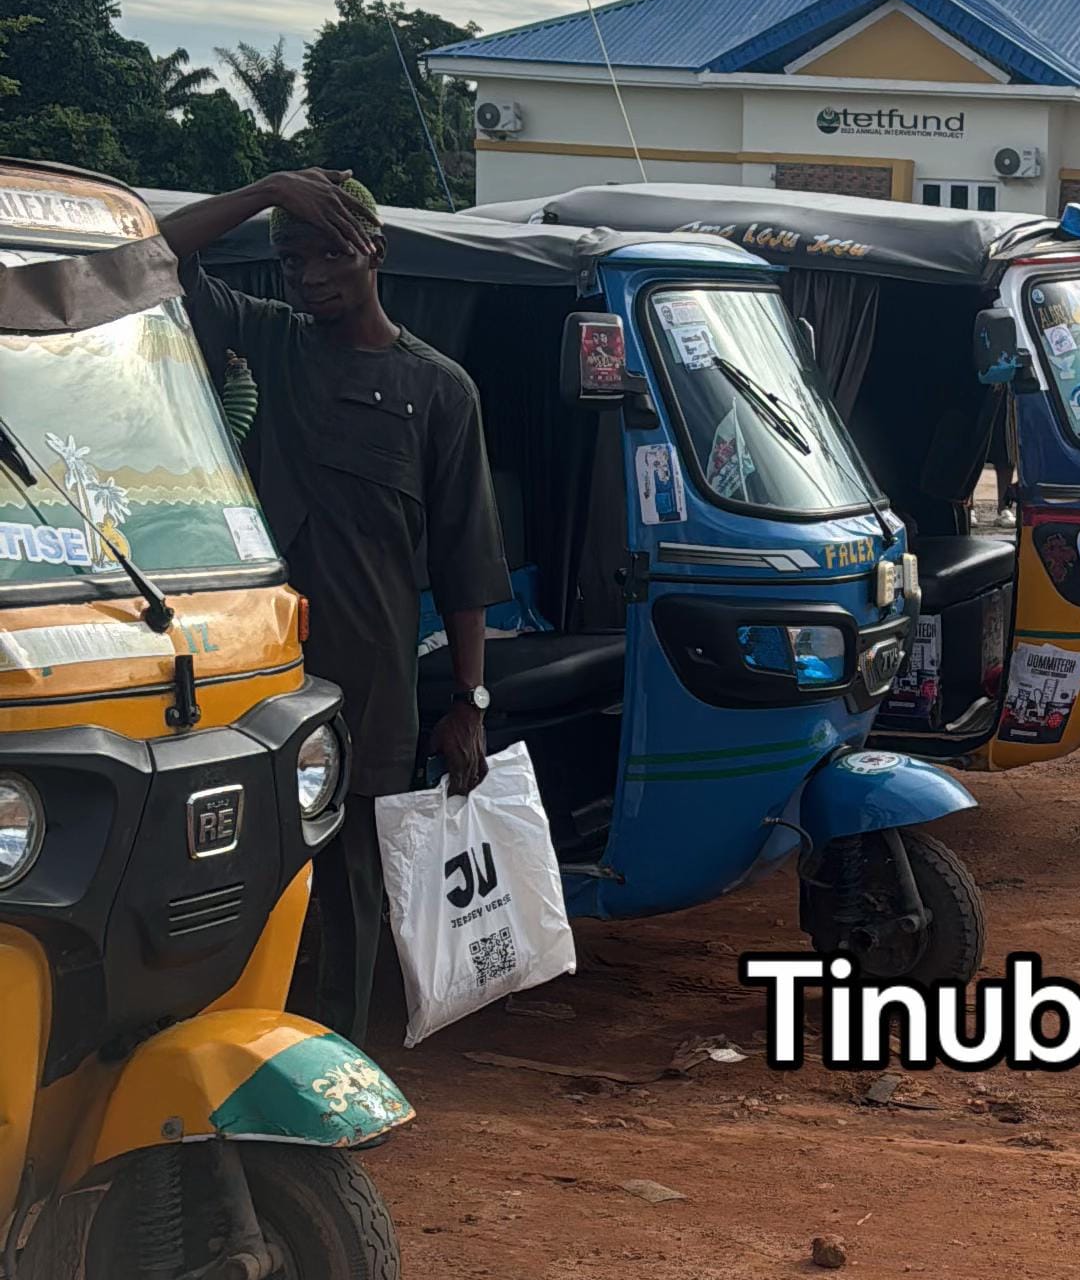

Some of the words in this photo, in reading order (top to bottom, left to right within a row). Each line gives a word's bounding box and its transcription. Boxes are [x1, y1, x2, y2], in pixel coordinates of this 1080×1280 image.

[841, 107, 965, 132] tetfund
[856, 128, 882, 136] ANNUAL
[884, 128, 932, 138] INTERVENTION
[933, 131, 964, 139] PROJECT
[0, 522, 89, 564] TISE
[825, 536, 876, 570] FALEX
[199, 807, 234, 843] RE
[450, 907, 483, 929] JERSEY
[485, 892, 512, 913] VERSE
